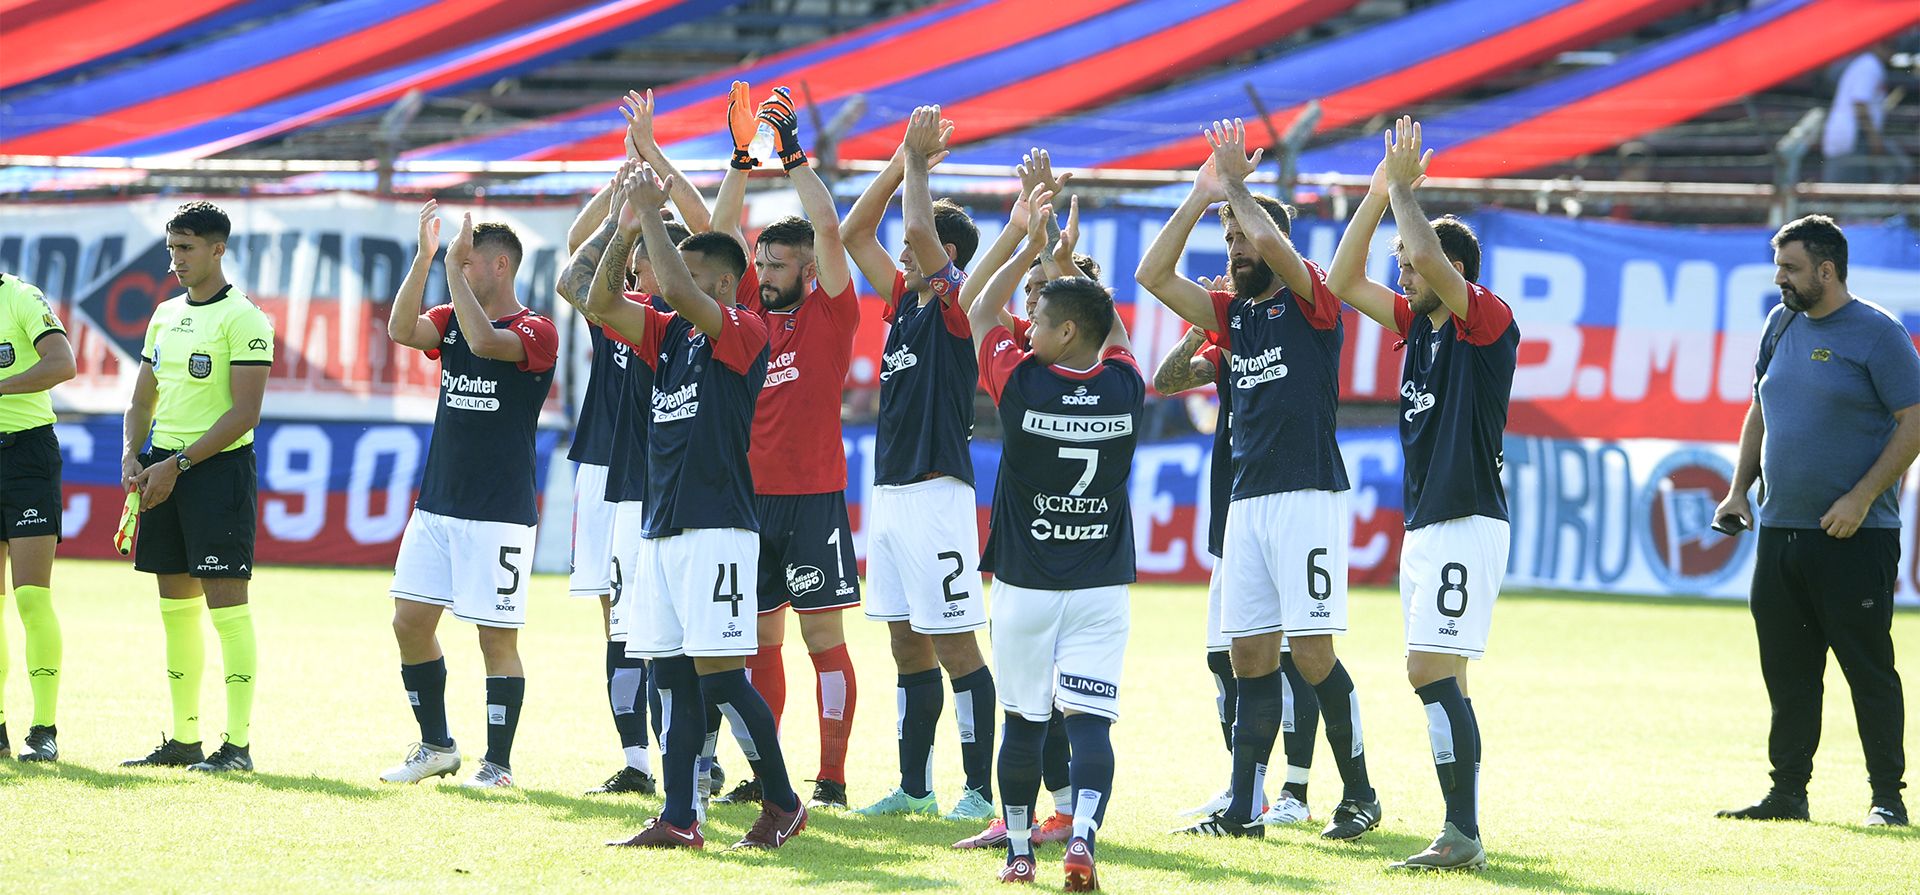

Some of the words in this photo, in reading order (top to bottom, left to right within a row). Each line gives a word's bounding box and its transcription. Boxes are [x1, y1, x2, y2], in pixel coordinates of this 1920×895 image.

[1031, 417, 1126, 433] ILLINOIS
[1058, 447, 1099, 496] 7
[16, 517, 47, 526] ATHIX
[1046, 495, 1109, 514] CRETA
[197, 564, 229, 572] ATHIX
[497, 546, 521, 595] 5
[827, 528, 844, 578] 1
[713, 563, 743, 617] 4
[790, 576, 820, 592] Trapo
[795, 570, 818, 583] Mister
[938, 551, 969, 602] 2
[1307, 548, 1331, 600] 6
[1437, 562, 1467, 618] 8
[1060, 675, 1115, 697] ILLINOIS
